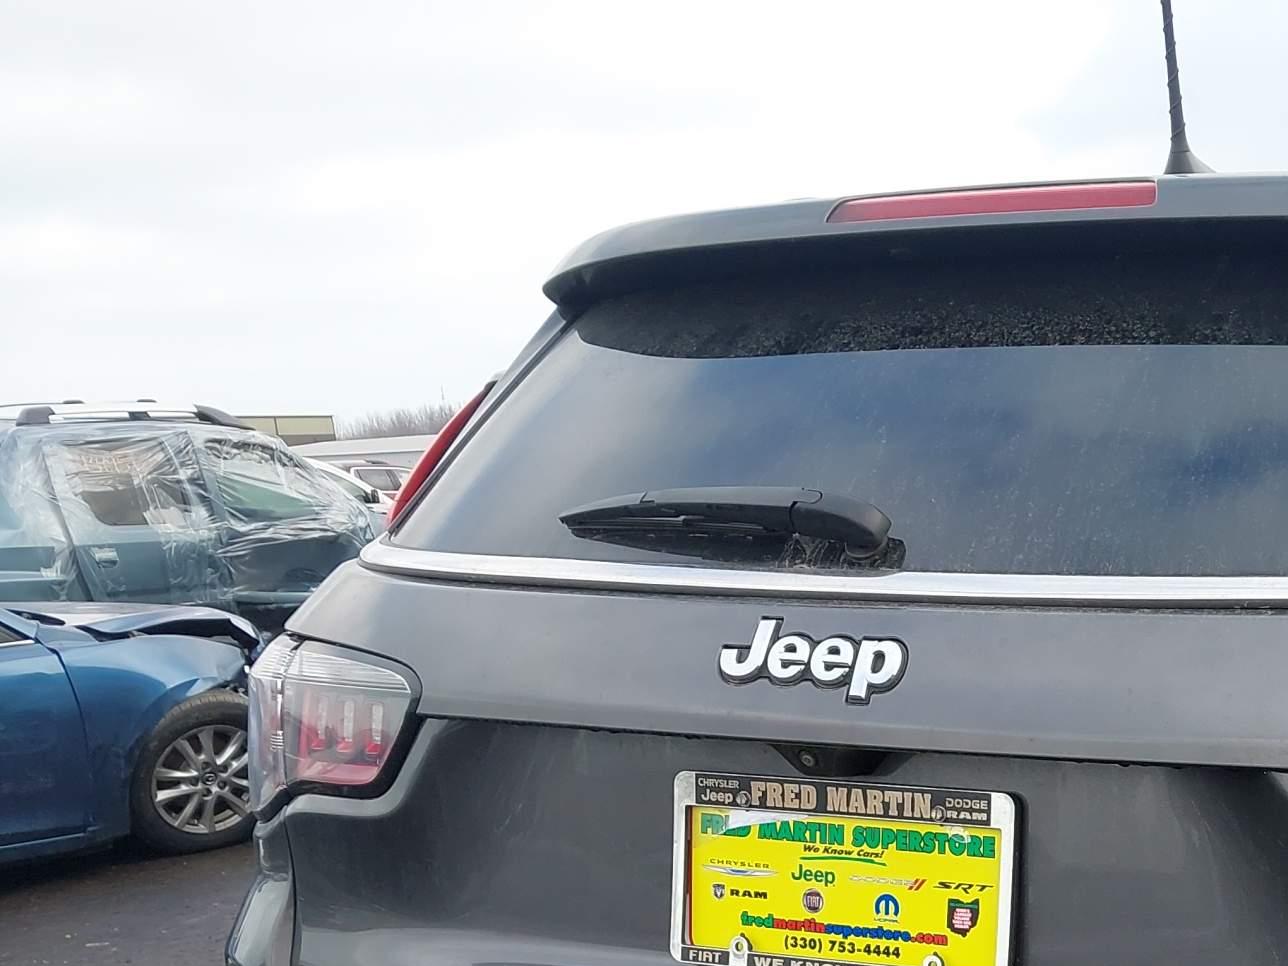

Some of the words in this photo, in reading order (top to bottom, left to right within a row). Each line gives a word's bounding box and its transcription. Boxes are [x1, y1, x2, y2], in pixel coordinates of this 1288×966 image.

[719, 616, 909, 704] Jeep
[698, 777, 739, 789] CHRYSLER
[701, 788, 733, 805] Jeep
[751, 780, 817, 810] FRED
[826, 786, 931, 819] MARTIN
[945, 797, 988, 810] DODGE
[946, 810, 988, 821] RAM
[757, 819, 845, 846] MARTIN
[851, 824, 996, 859] SUPERSTORE
[803, 843, 820, 853] We
[822, 846, 855, 856] Know
[856, 848, 885, 858] Cars!
[709, 858, 770, 869] CHRYSLER
[791, 863, 836, 887] Jeep
[729, 888, 768, 900] RAM
[933, 881, 994, 894] SRT
[806, 895, 820, 908] FIAT
[740, 910, 949, 946] fredmartinsuperstore.com
[784, 935, 823, 953] (330)
[828, 939, 901, 959] 753-4444
[688, 950, 722, 963] FIAT
